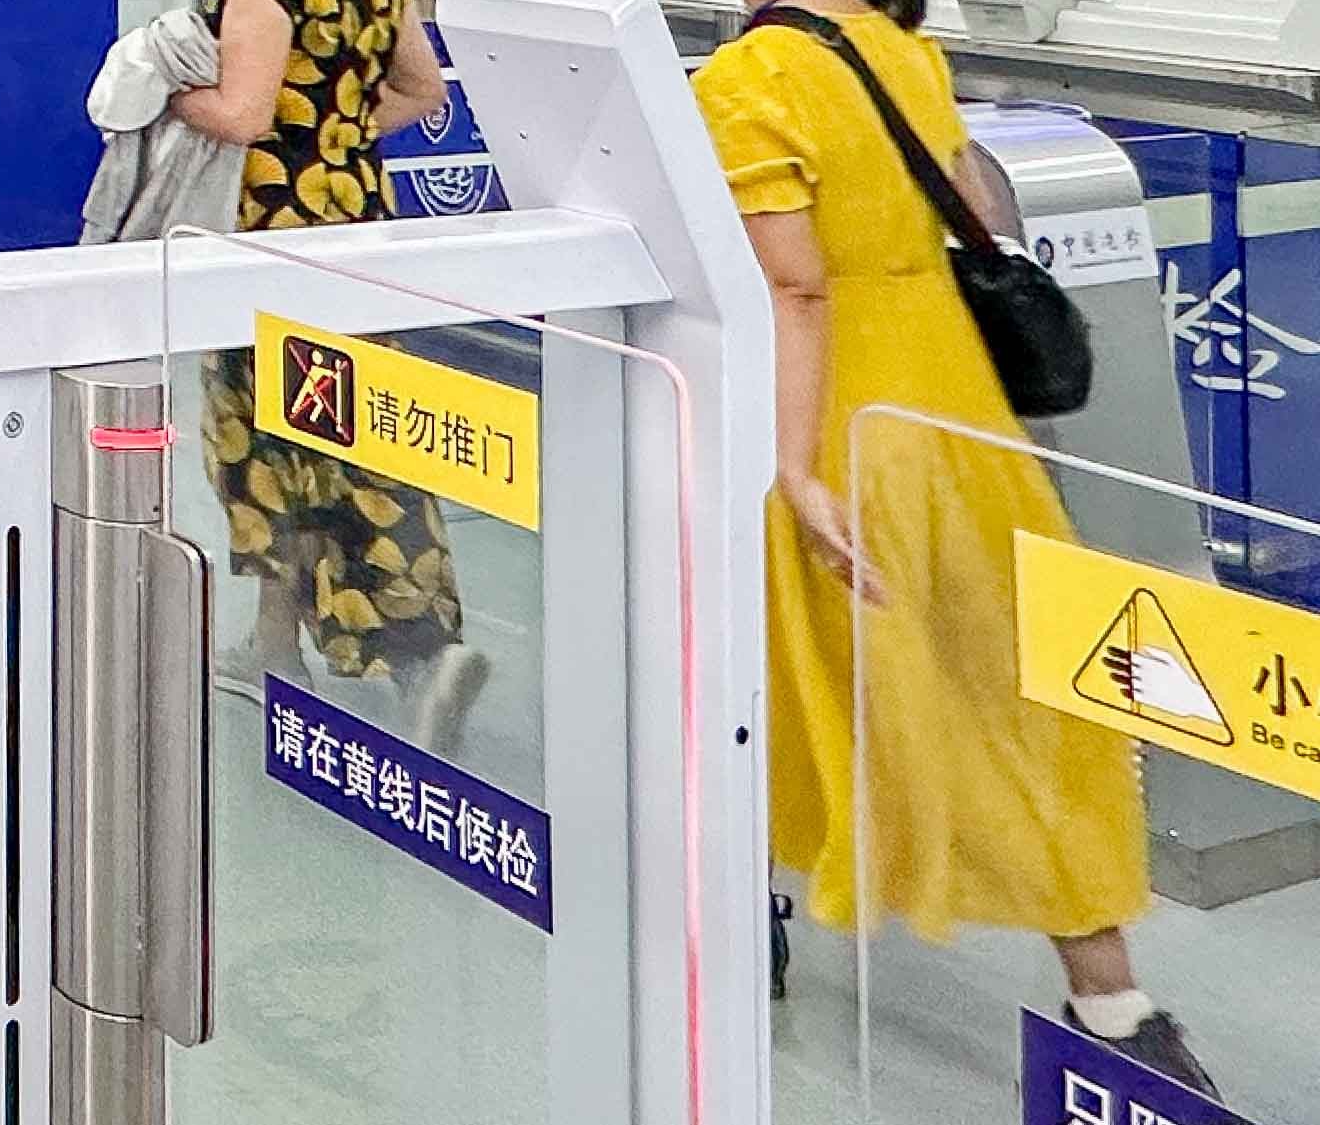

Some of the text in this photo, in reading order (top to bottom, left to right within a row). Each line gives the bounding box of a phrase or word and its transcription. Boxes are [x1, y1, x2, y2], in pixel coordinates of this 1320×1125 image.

[366, 385, 516, 486] 请勿推门
[1252, 653, 1320, 717] 小
[1252, 722, 1285, 750] Be
[271, 701, 539, 897] 请在黄线后候检
